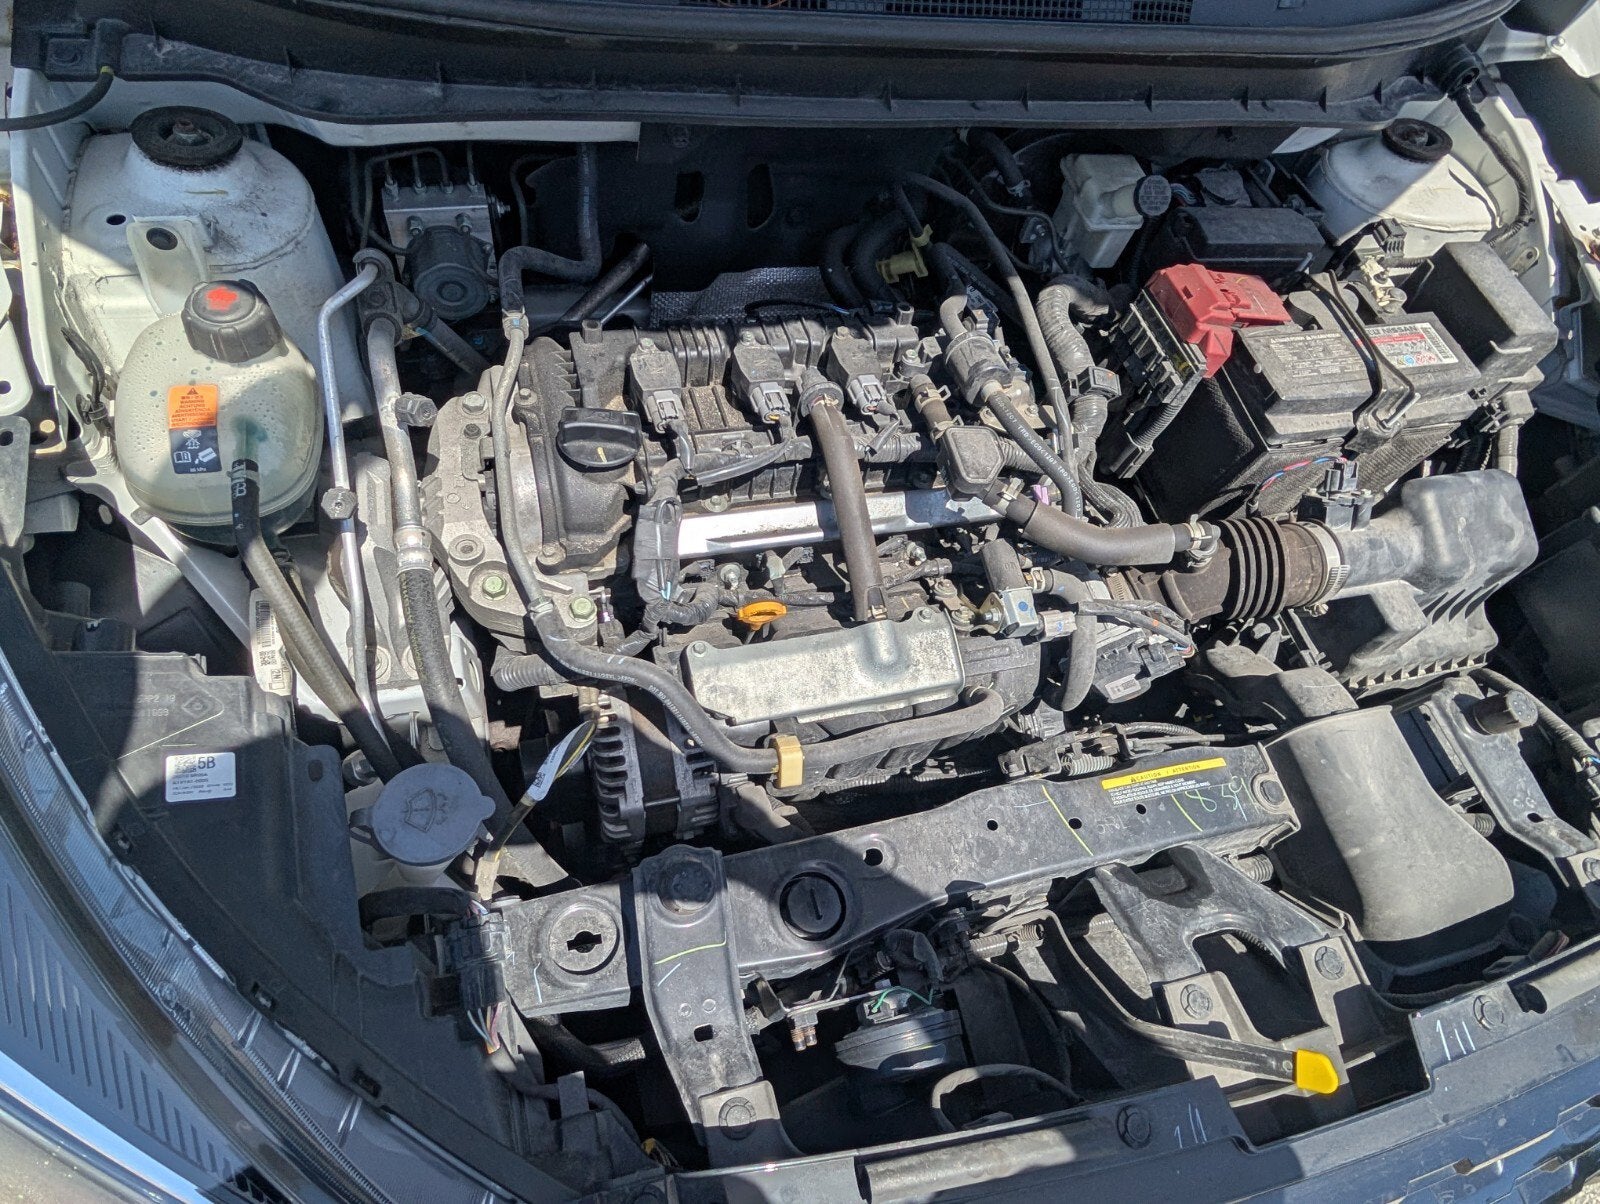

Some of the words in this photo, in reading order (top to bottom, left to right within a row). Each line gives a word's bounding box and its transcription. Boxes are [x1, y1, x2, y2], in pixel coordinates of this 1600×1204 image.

[1381, 325, 1418, 334] NISSAN
[197, 756, 216, 770] 5B
[1135, 771, 1162, 782] CAUTION
[1172, 764, 1201, 776] ATTENTION
